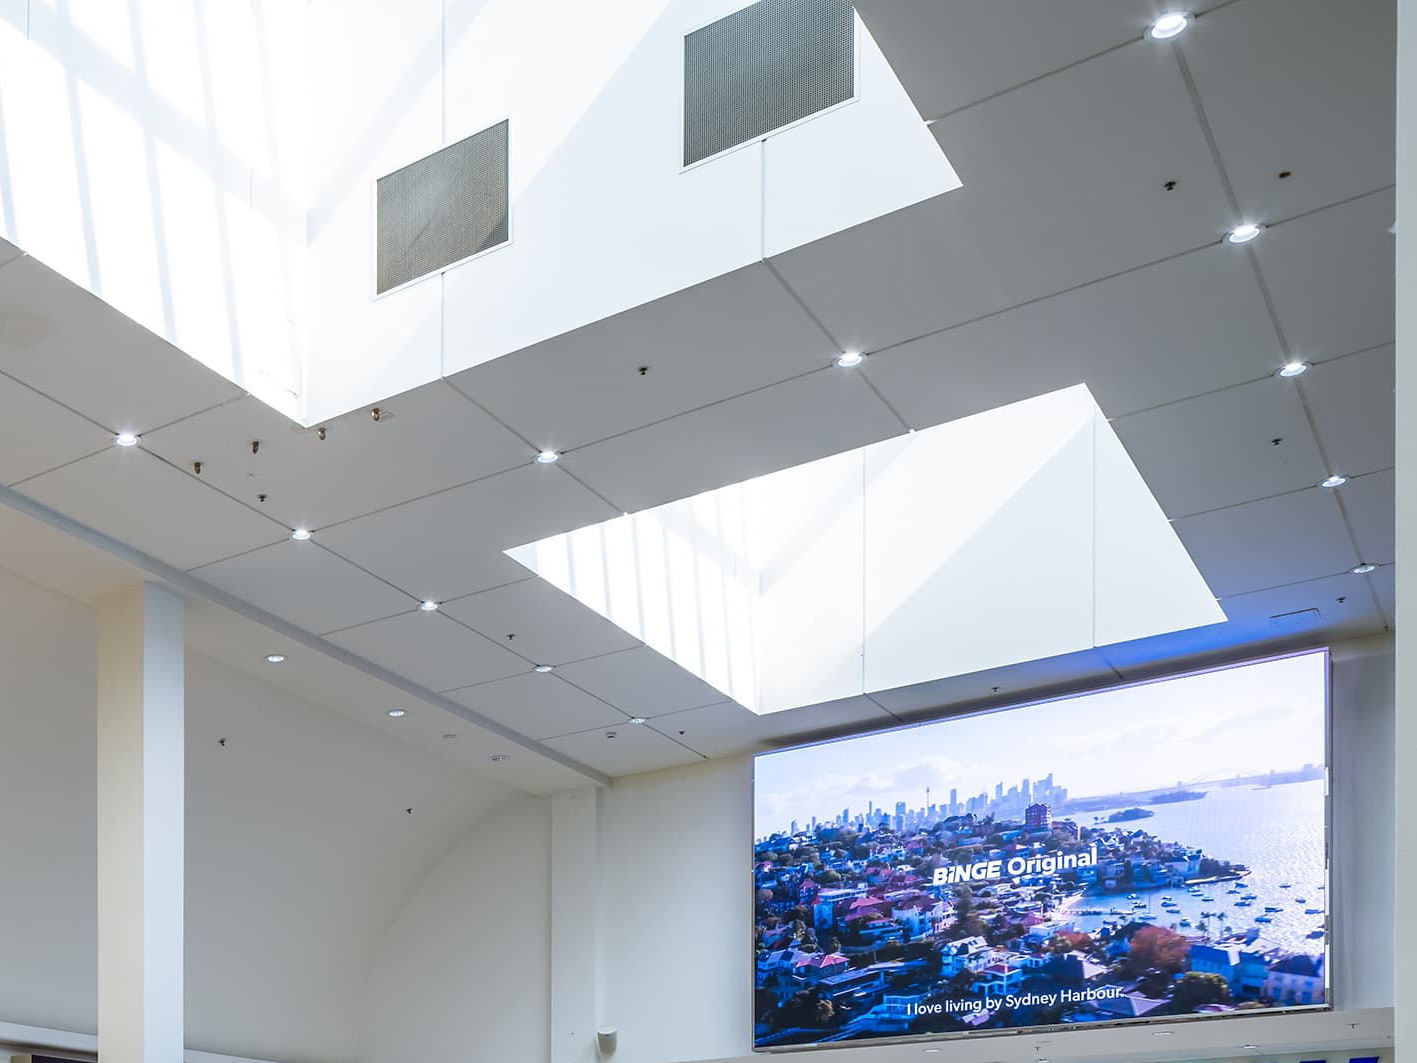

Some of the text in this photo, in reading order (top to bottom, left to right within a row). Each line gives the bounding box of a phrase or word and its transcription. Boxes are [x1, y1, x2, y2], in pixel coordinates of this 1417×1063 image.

[1007, 843, 1097, 876] Original
[907, 986, 1126, 1015] I love living by Sydney Harbour.
